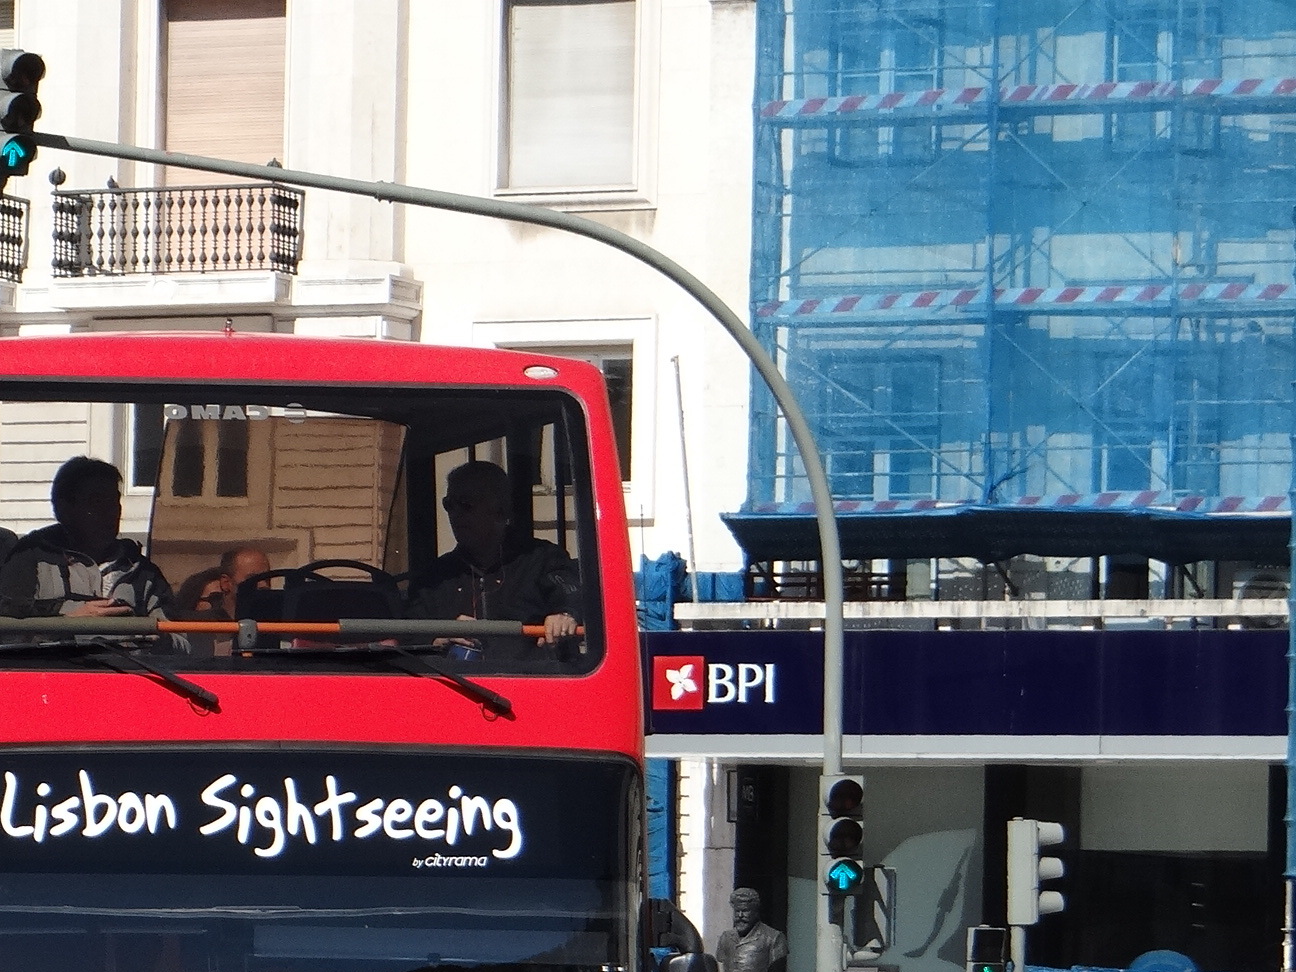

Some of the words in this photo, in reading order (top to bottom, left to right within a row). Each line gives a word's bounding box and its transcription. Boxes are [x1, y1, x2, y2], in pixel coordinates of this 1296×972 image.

[707, 663, 776, 703] BPI
[0, 769, 176, 843] Lisbon
[198, 773, 522, 860] Sightseeing
[412, 857, 424, 868] by
[424, 853, 487, 868] cityrama
